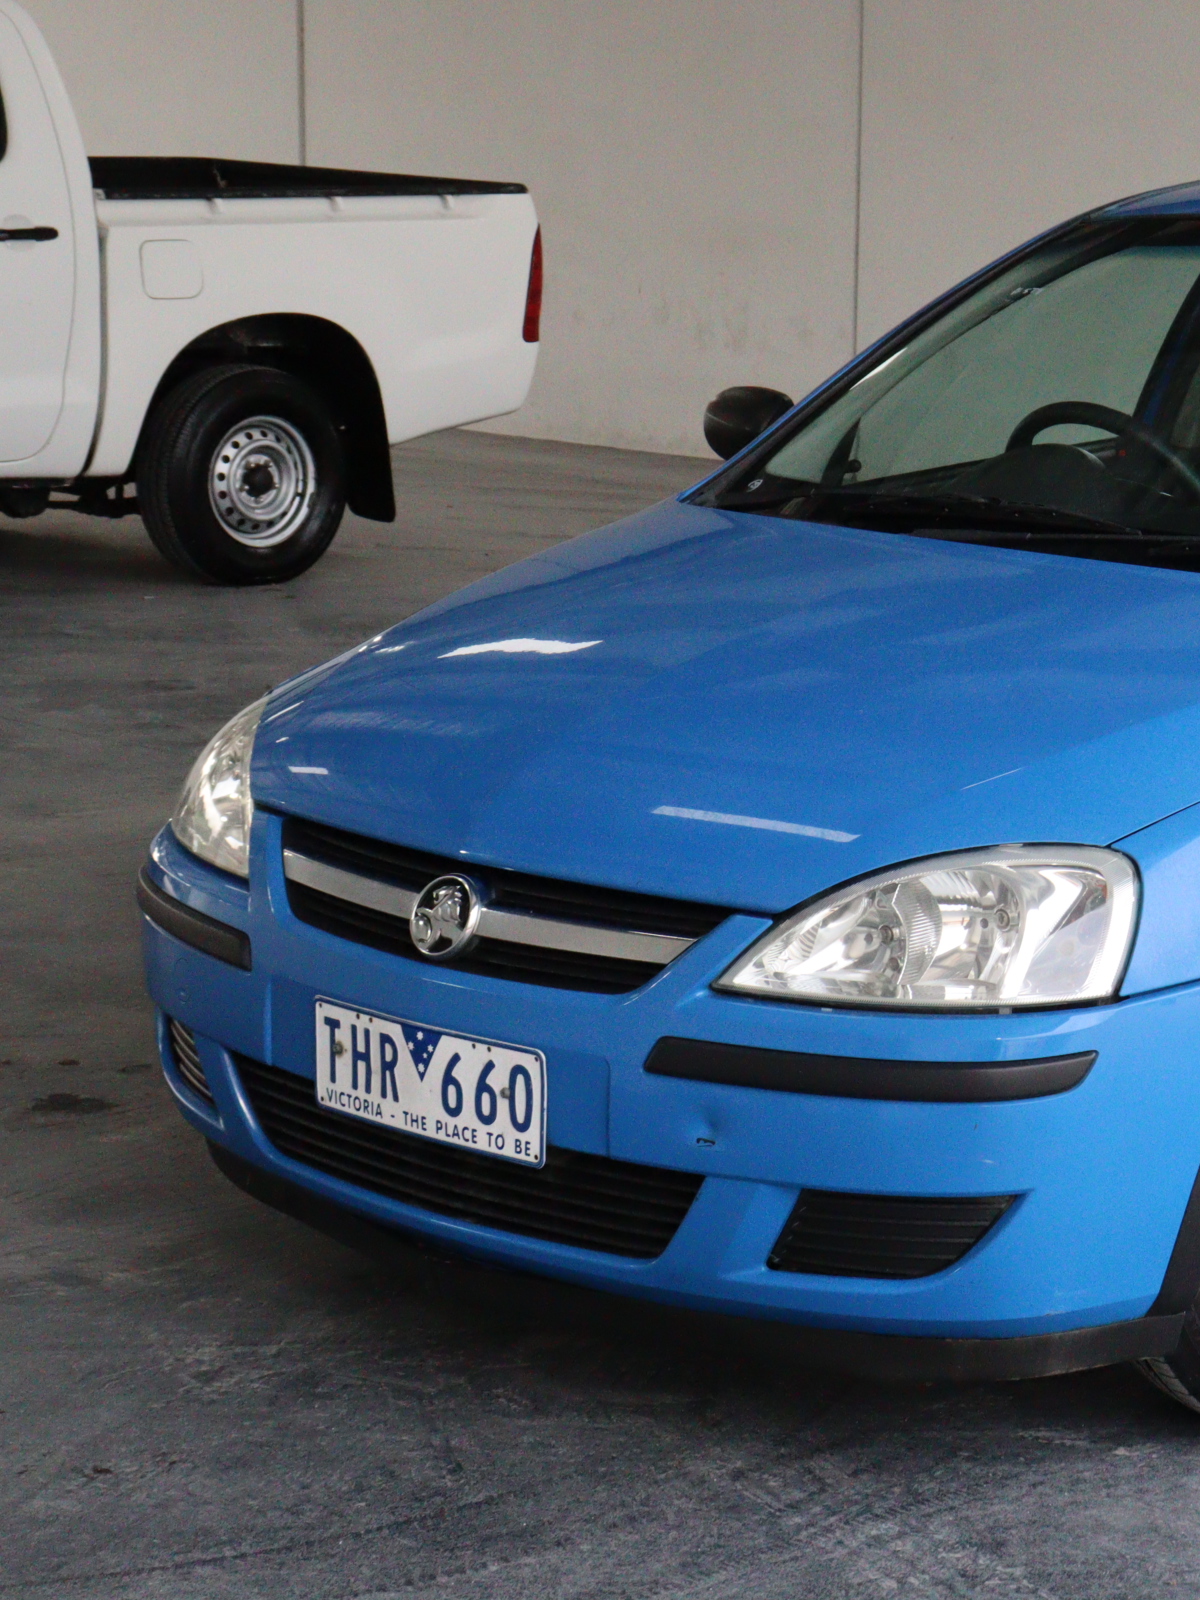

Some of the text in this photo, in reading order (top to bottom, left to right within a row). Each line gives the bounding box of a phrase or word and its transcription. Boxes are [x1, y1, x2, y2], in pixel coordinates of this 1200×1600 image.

[324, 1016, 534, 1133] THR 660
[326, 1087, 384, 1119] VICTORIA
[402, 1110, 427, 1132] THE
[436, 1120, 478, 1144] PLACE
[486, 1132, 505, 1150] TO
[514, 1139, 532, 1157] BE
